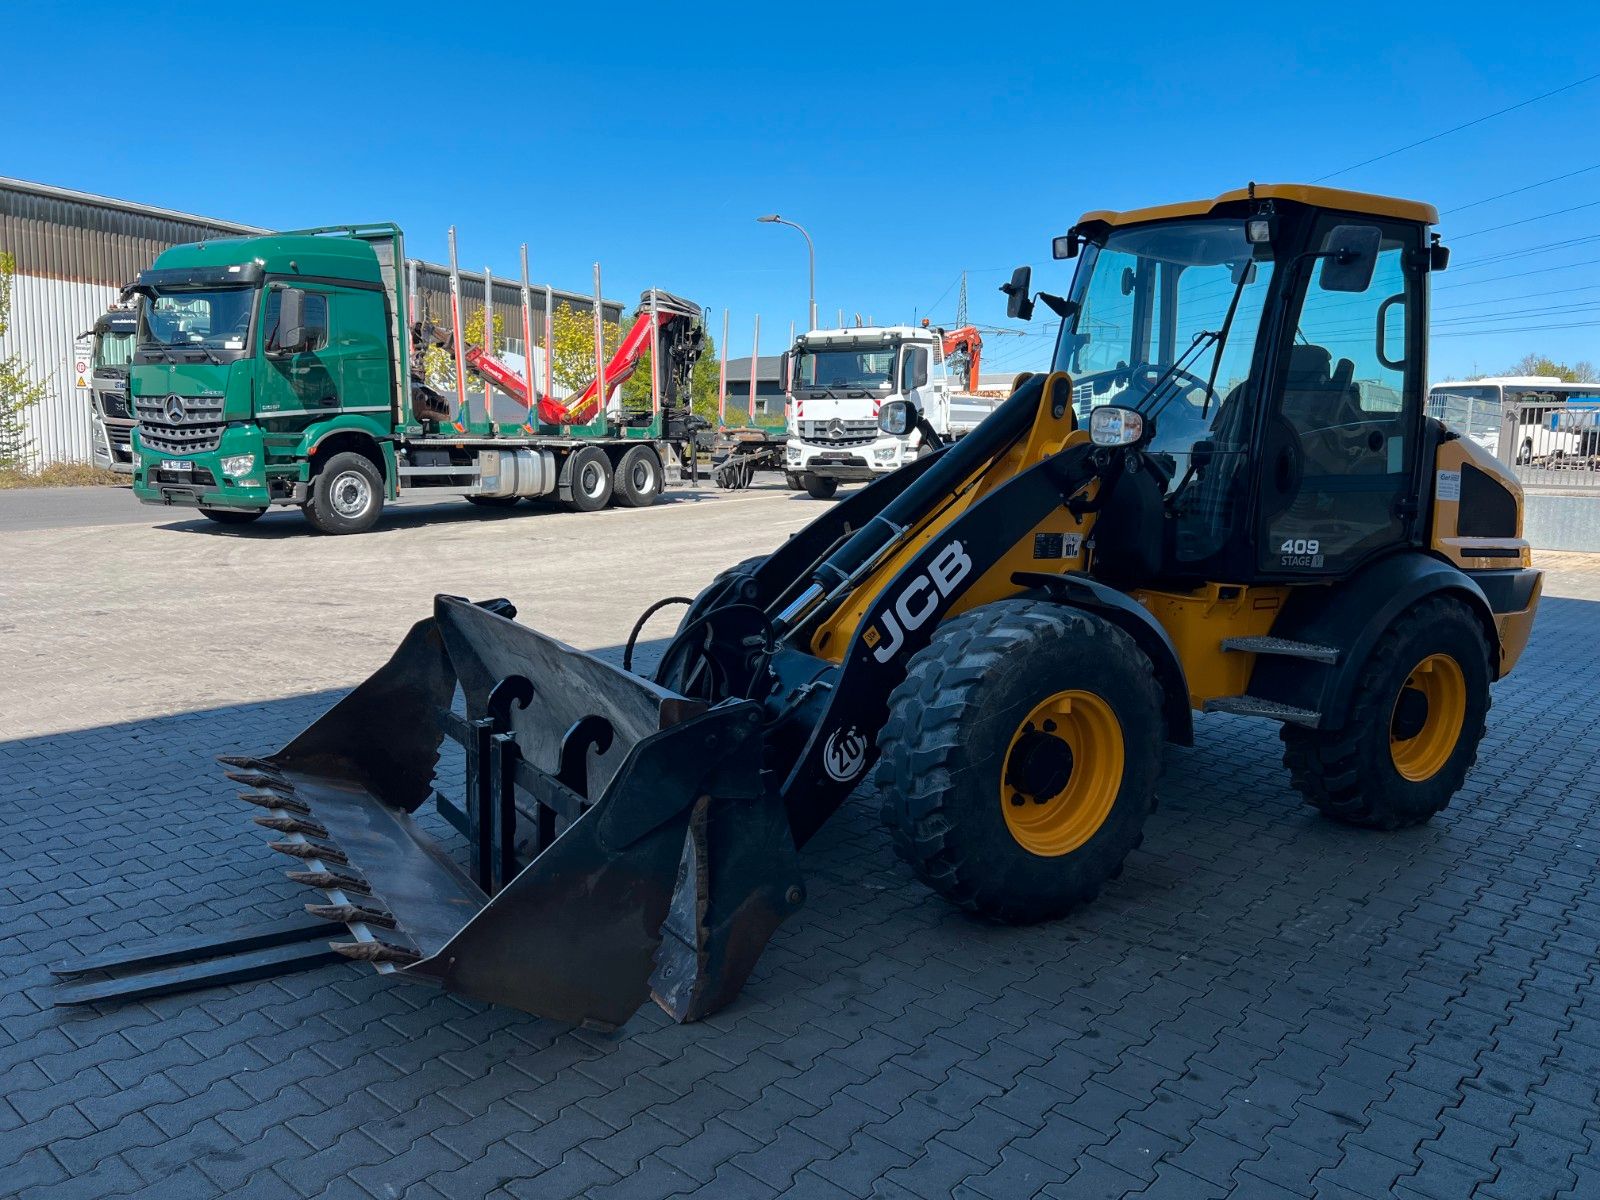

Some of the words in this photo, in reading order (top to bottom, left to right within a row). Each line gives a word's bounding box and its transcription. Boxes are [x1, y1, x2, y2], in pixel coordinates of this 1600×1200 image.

[1281, 539, 1319, 554] 409
[1281, 556, 1311, 566] STAGE
[874, 540, 973, 664] JCB
[831, 734, 861, 774] 20
